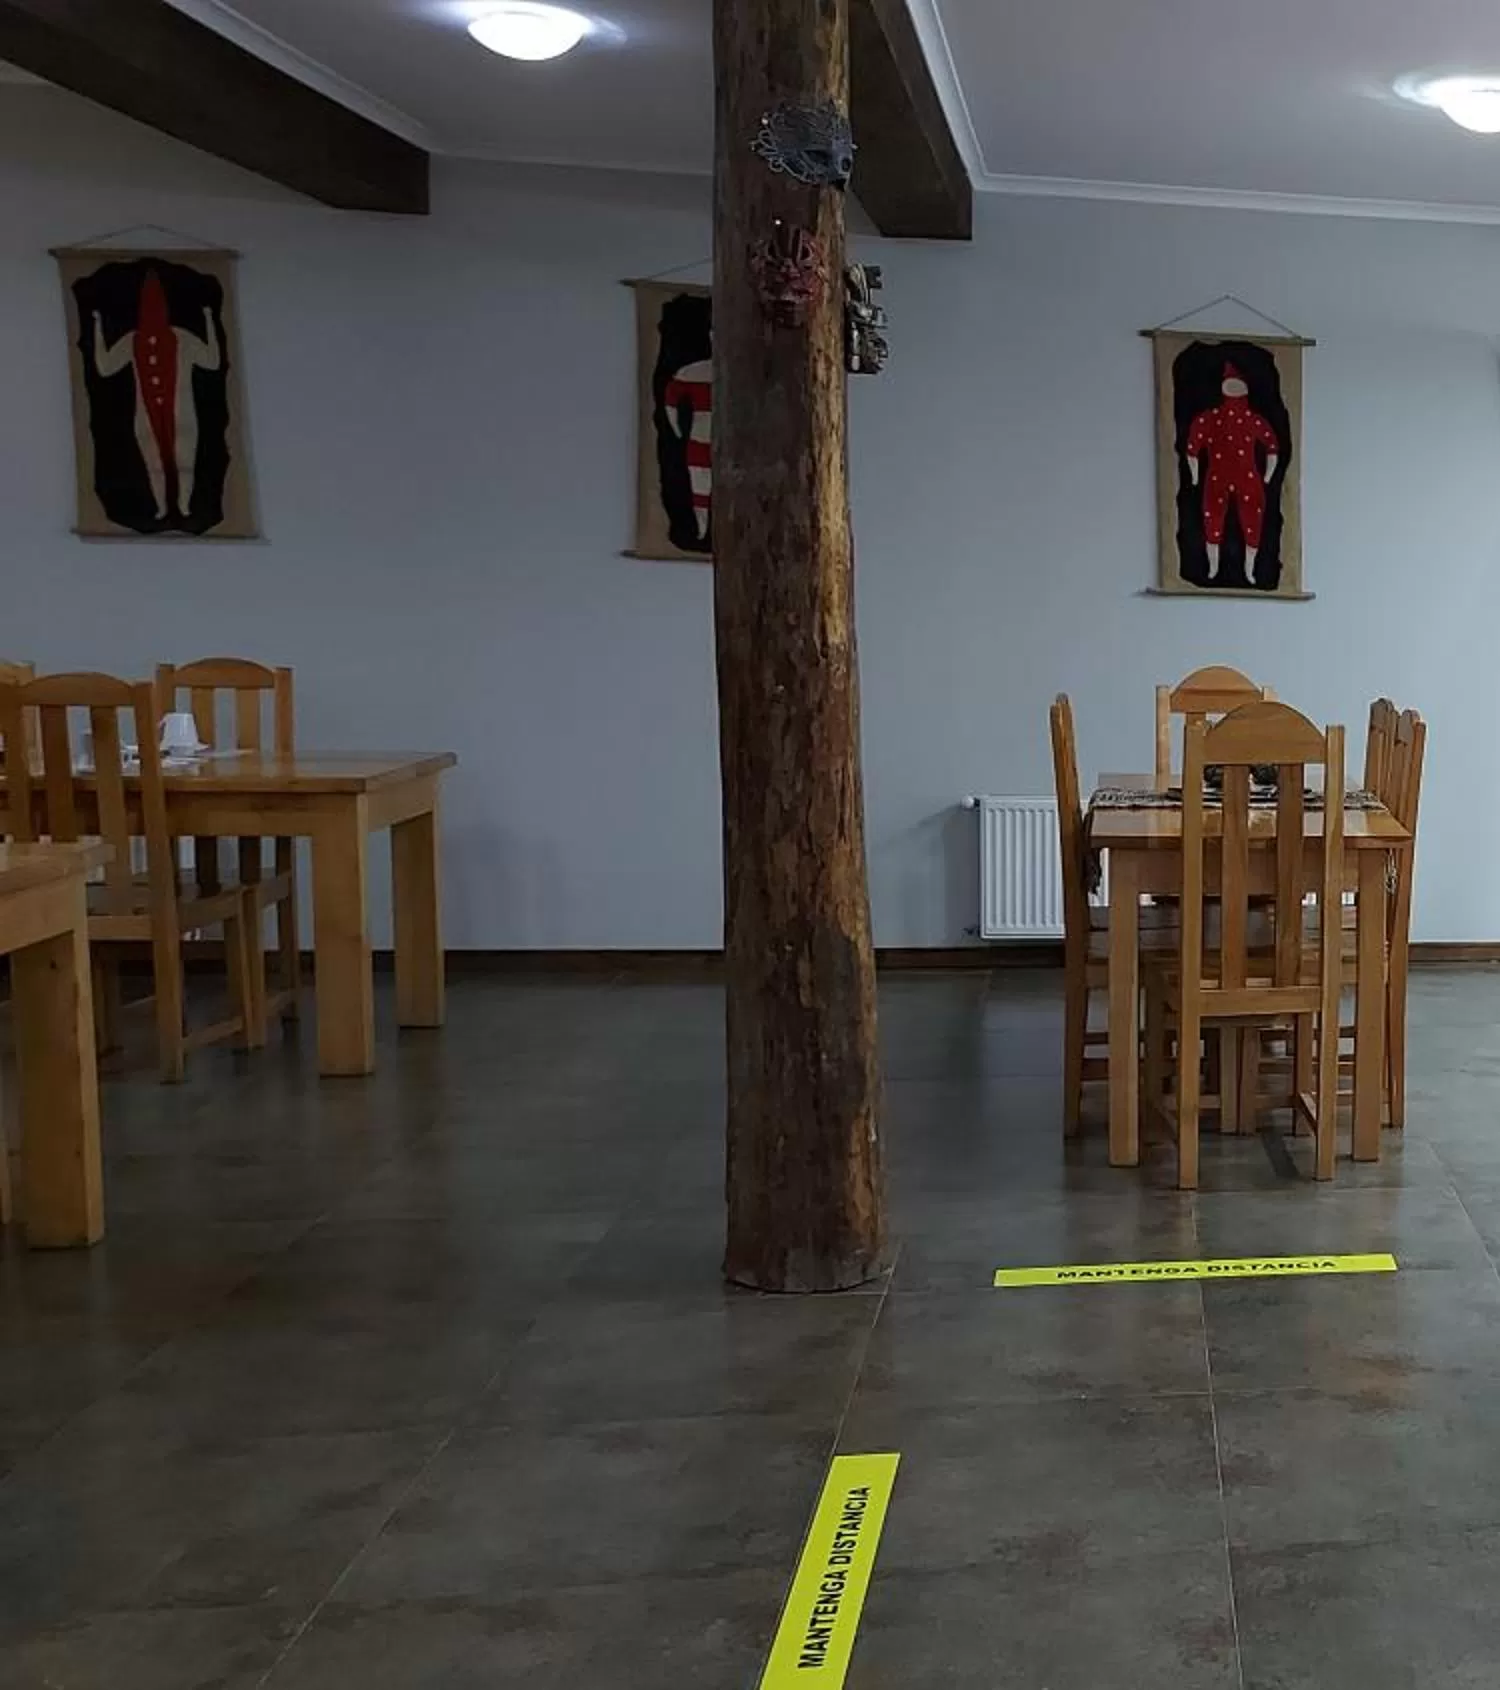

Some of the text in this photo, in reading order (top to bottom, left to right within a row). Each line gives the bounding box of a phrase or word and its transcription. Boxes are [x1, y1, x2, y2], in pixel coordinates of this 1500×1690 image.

[1056, 1260, 1336, 1279] MANTENGA DISTANCIA
[798, 1486, 871, 1669] MANTENGA DISTANCIA
